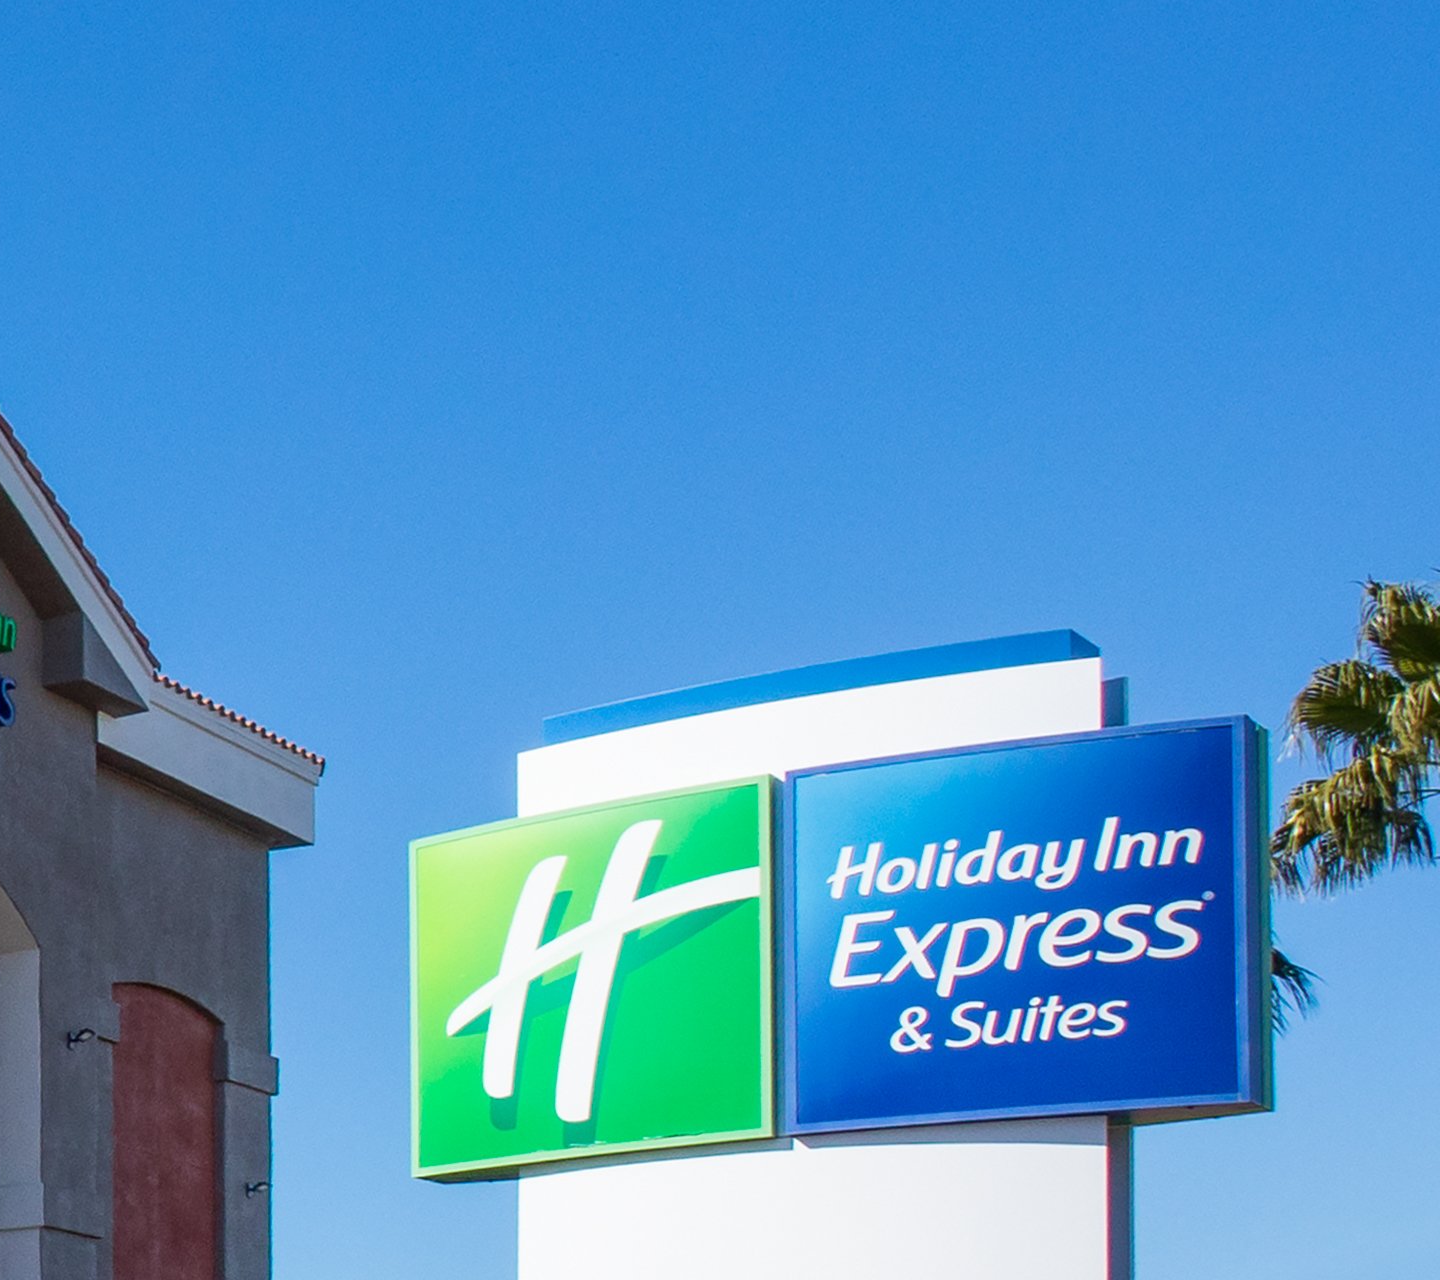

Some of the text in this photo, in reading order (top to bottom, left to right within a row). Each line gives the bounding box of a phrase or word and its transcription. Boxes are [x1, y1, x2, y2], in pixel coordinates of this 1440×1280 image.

[827, 817, 1204, 898] Holiday Inn
[830, 899, 1205, 997] Express
[889, 995, 1127, 1054] & Suites
